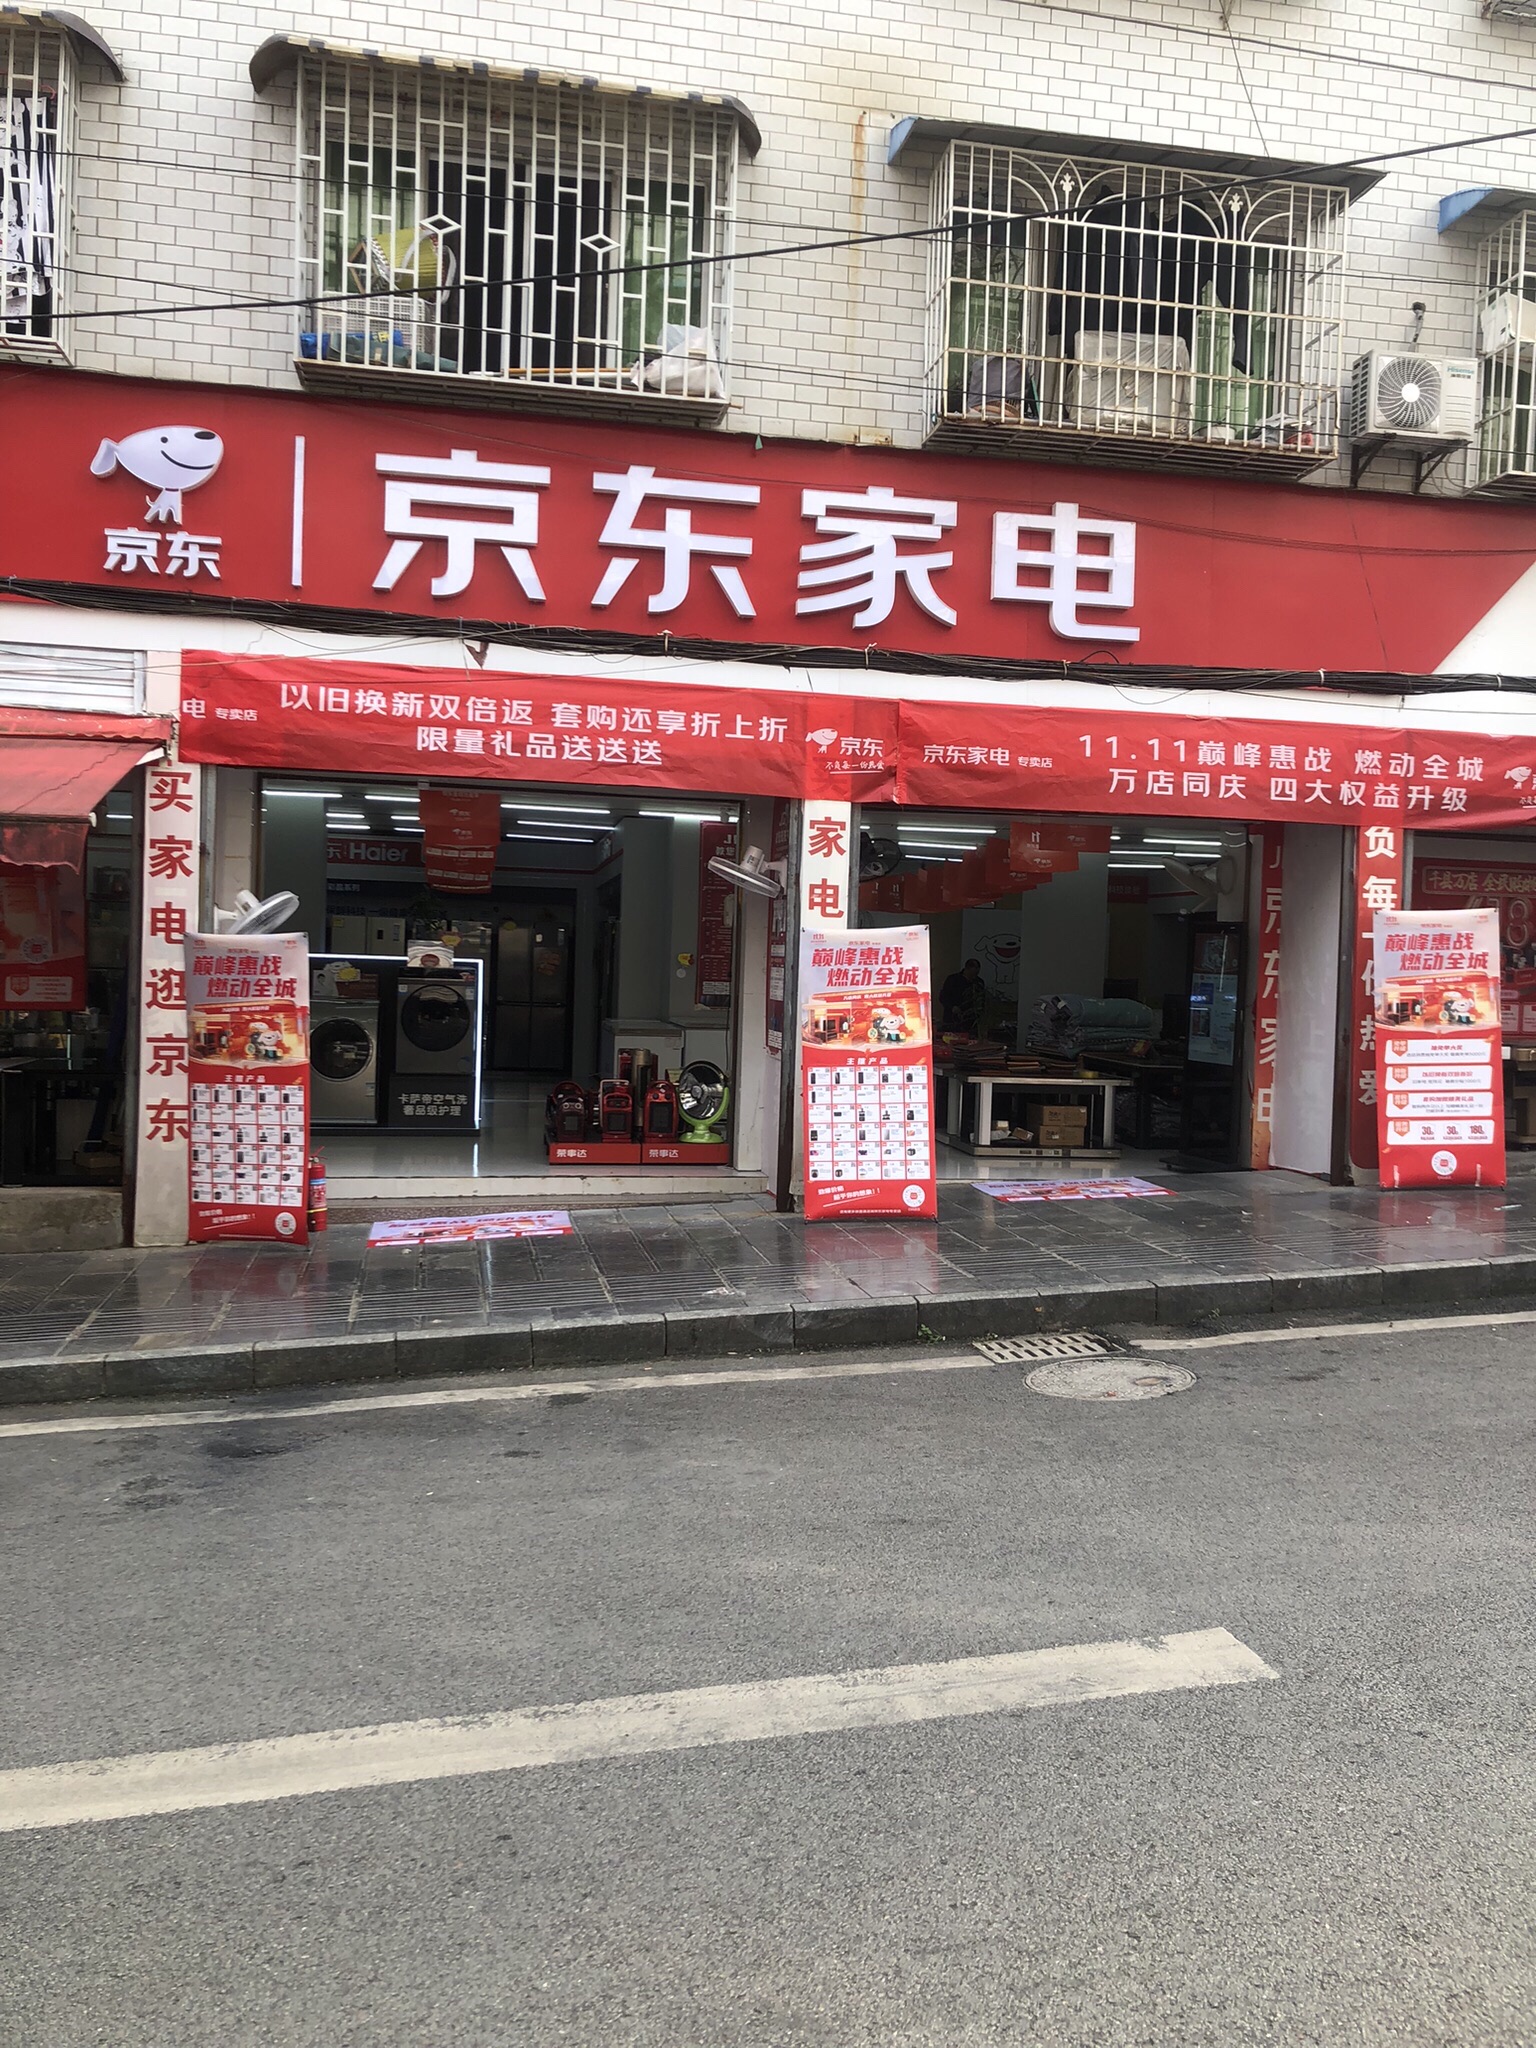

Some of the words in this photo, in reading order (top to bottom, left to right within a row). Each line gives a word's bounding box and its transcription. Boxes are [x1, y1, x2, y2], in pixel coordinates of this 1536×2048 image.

[103, 527, 222, 580] 京东
[372, 448, 1142, 643] 京东家电
[215, 707, 258, 722] 专卖店
[281, 683, 533, 726] 以旧换新双倍返
[551, 702, 788, 743] 套购还享折上折
[416, 726, 662, 765] 限量礼品送送送
[840, 737, 883, 757] 京东
[923, 745, 1010, 766] 京东家电
[1017, 756, 1052, 768] 专卖店
[1354, 749, 1484, 782] 燃动全城
[1109, 768, 1247, 799] 万店同庆
[1270, 777, 1468, 812] 四大权益升级
[1385, 932, 1474, 952] 巅峰惠战
[145, 771, 194, 1142] 买家电逛京东
[193, 955, 283, 976] 巅峰惠战
[811, 946, 904, 967] 巅峰惠战
[1399, 952, 1489, 971] 燃动全城
[826, 966, 919, 987] 燃动全城
[206, 977, 298, 998] 燃动全城
[556, 1148, 587, 1158] 荣事达
[649, 1148, 679, 1158] 荣事达
